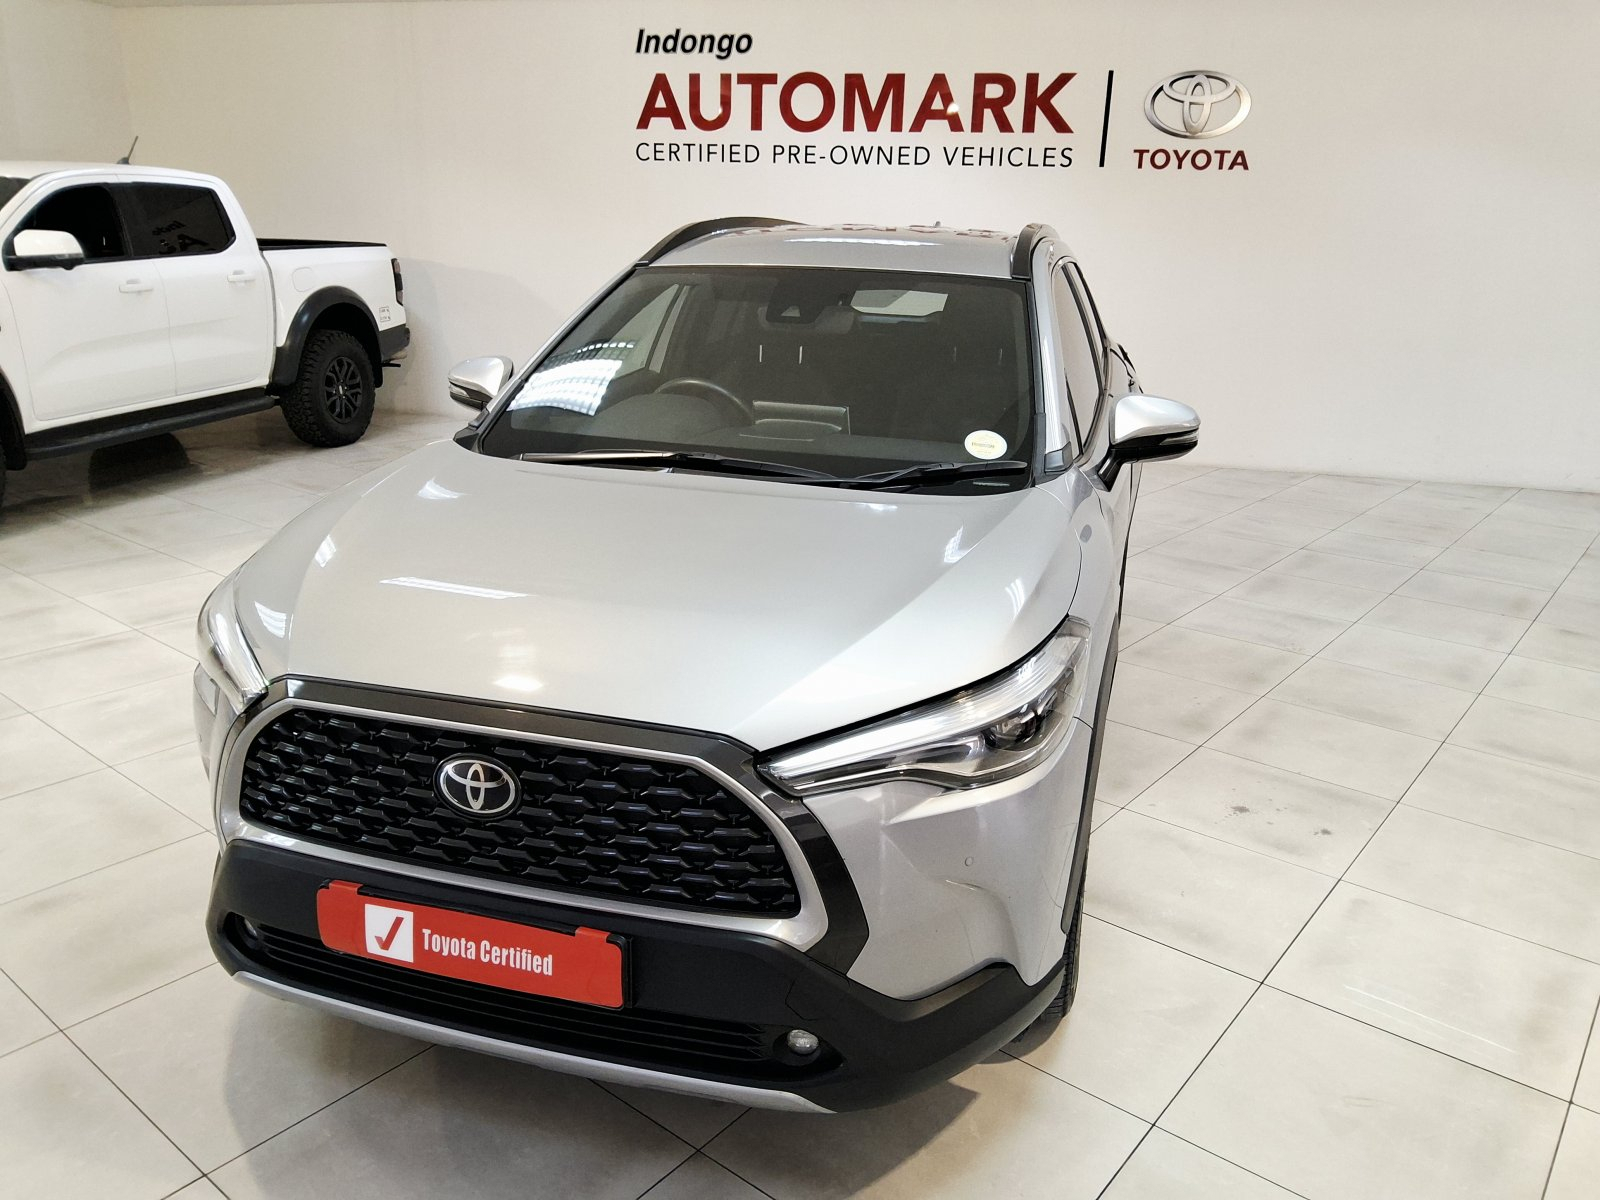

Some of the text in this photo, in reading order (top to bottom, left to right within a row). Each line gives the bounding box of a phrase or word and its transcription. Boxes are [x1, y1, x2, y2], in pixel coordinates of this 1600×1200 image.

[635, 28, 753, 60] Indongo
[636, 72, 1077, 134] AUTOMARK
[635, 142, 1073, 168] CERTIFIED PRE-OWNED VEHICLES
[1133, 149, 1250, 171] TOYOTA
[422, 928, 553, 977] Toyota Certified
